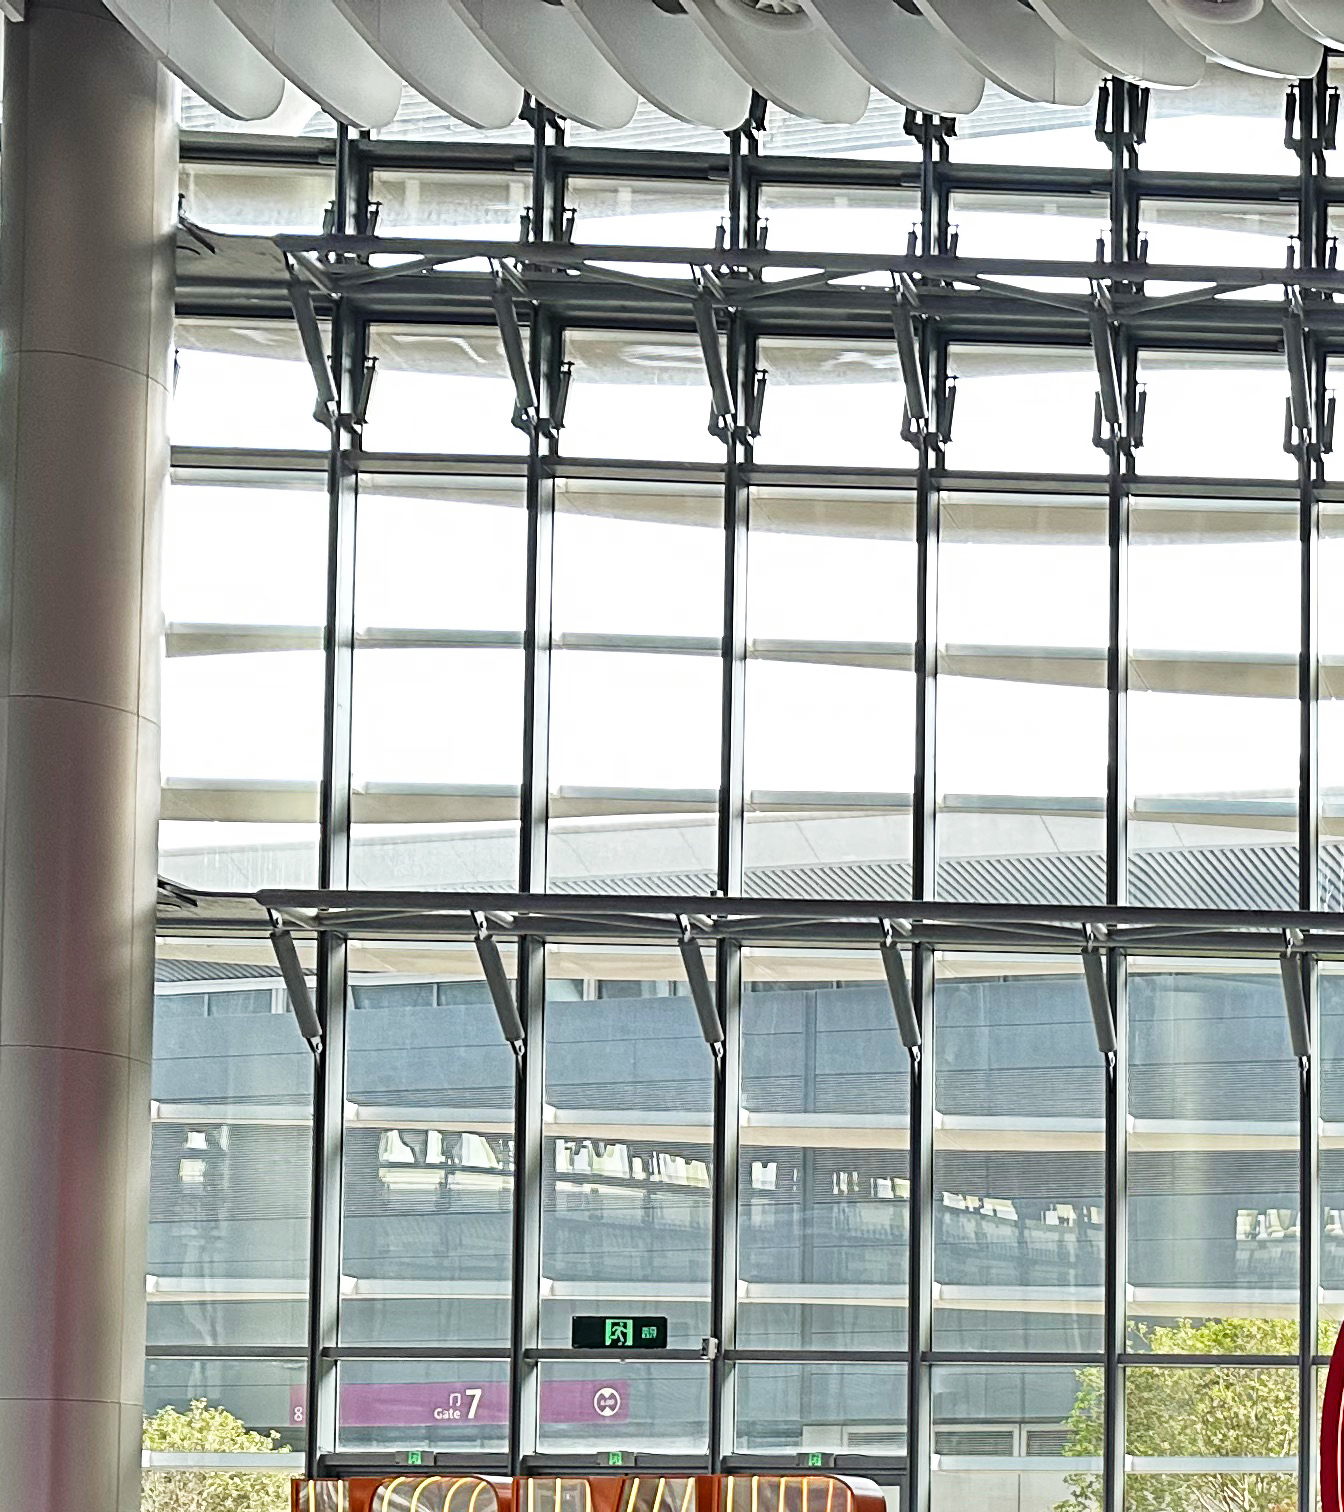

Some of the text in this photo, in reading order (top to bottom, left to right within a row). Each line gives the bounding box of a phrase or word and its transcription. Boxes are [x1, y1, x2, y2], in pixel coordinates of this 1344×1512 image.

[293, 1406, 304, 1421] 8
[434, 1388, 482, 1420] Gate 7
